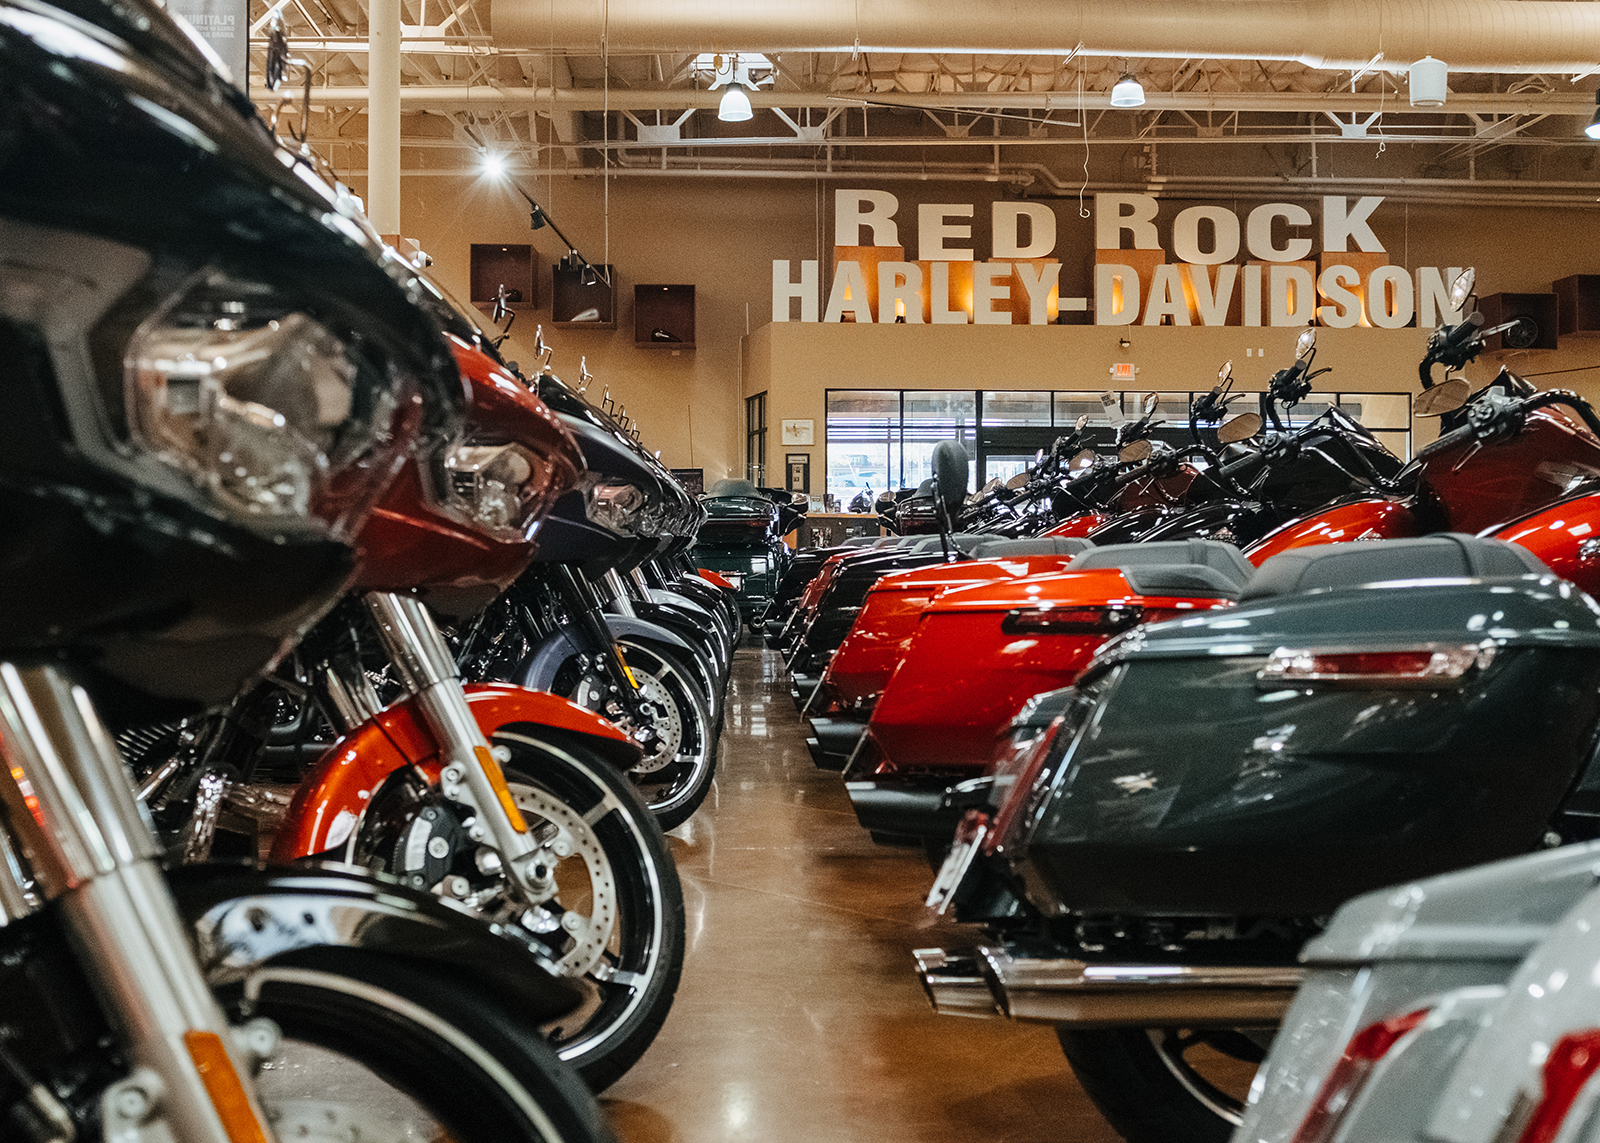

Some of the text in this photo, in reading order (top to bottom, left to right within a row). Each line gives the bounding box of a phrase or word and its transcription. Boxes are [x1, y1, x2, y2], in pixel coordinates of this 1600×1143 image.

[834, 188, 1386, 265] RED ROCK
[771, 259, 1464, 328] HARLEY-DAVIDSON
[1117, 364, 1131, 376] EXIT
